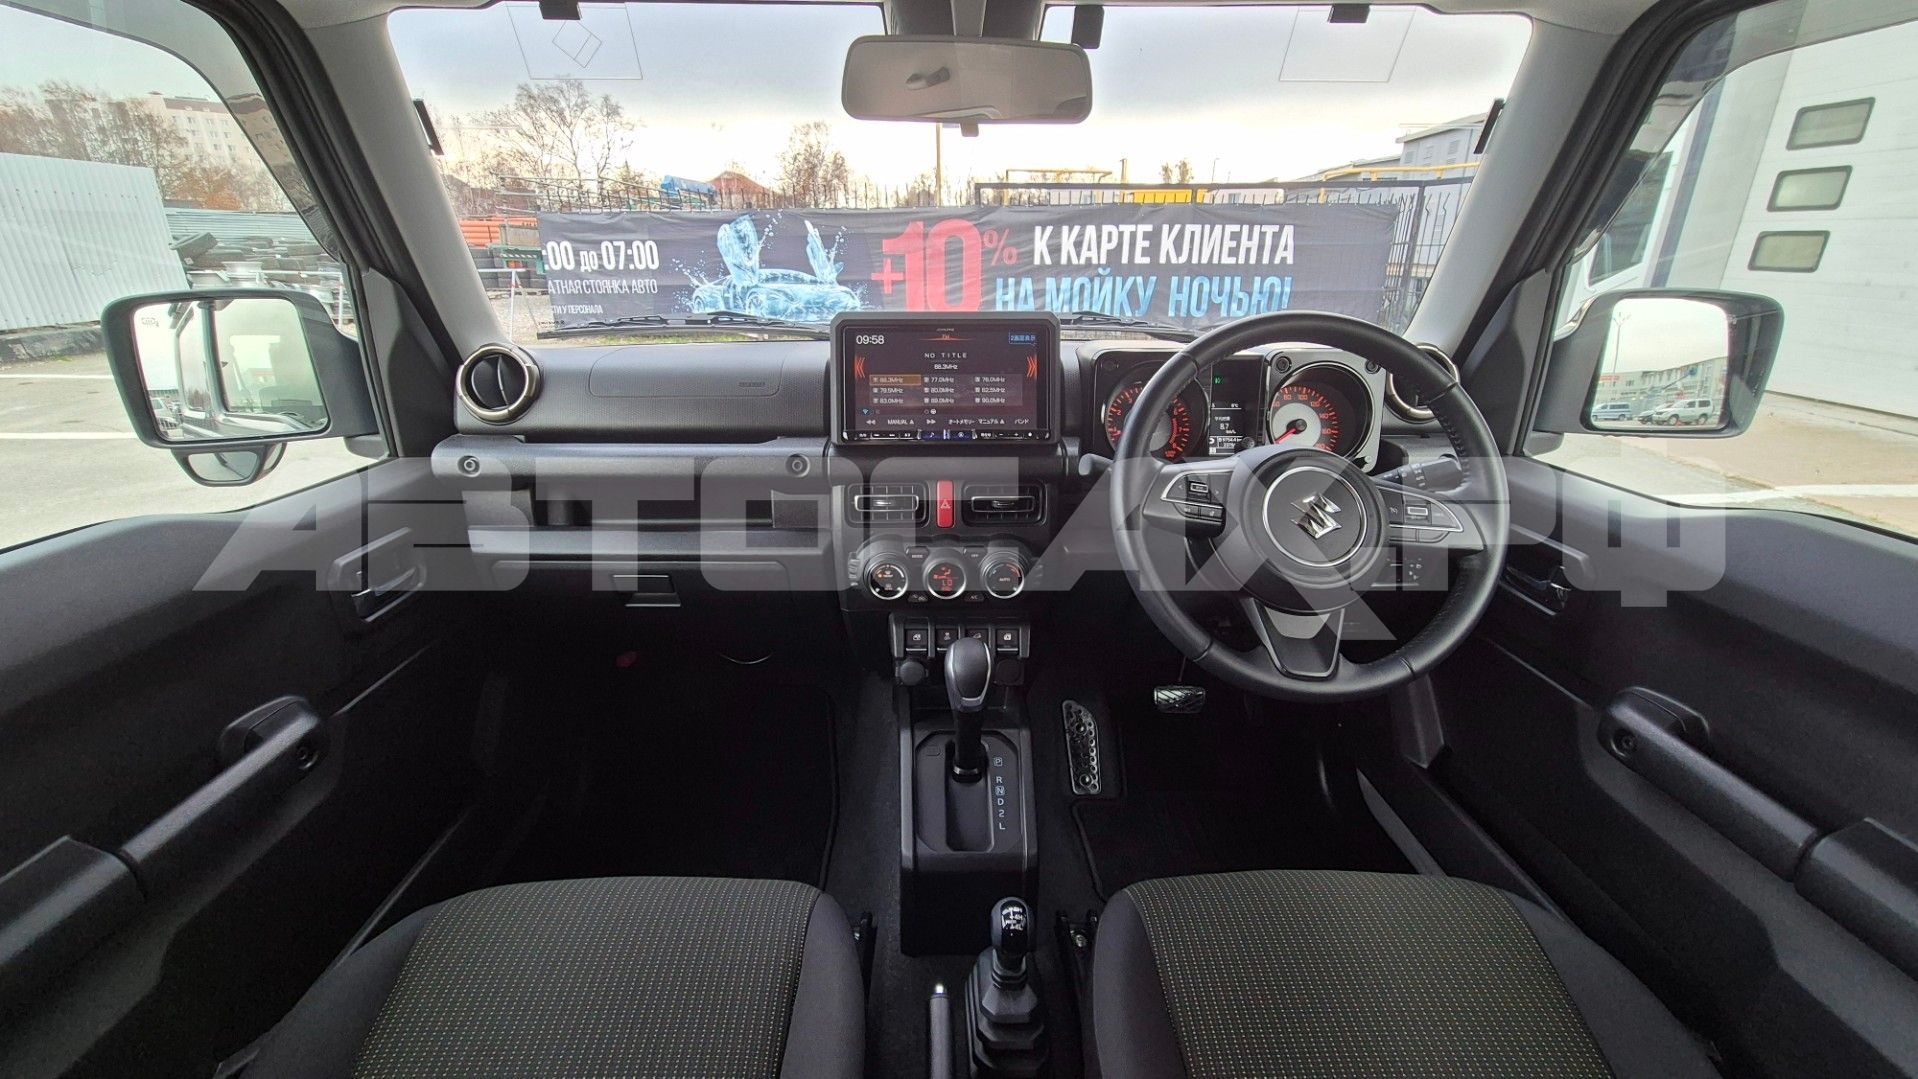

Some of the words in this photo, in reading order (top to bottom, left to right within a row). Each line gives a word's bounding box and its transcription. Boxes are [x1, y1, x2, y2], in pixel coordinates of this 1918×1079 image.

[1033, 225, 1053, 265] К
[1060, 224, 1153, 264] КАРТЕ
[1159, 223, 1294, 264] КЛИЕНТА
[600, 240, 660, 270] 07:00
[583, 279, 629, 294] СТОЯНКА
[631, 278, 658, 294] АВТО
[995, 277, 1036, 311] НА
[1044, 267, 1158, 317] МОЙКУ
[1168, 275, 1293, 318] НОЧЬЮ!
[855, 334, 885, 345] 09:58
[996, 776, 1003, 784] R
[997, 798, 1005, 806] D
[998, 809, 1005, 818] 2
[999, 822, 1006, 830] L
